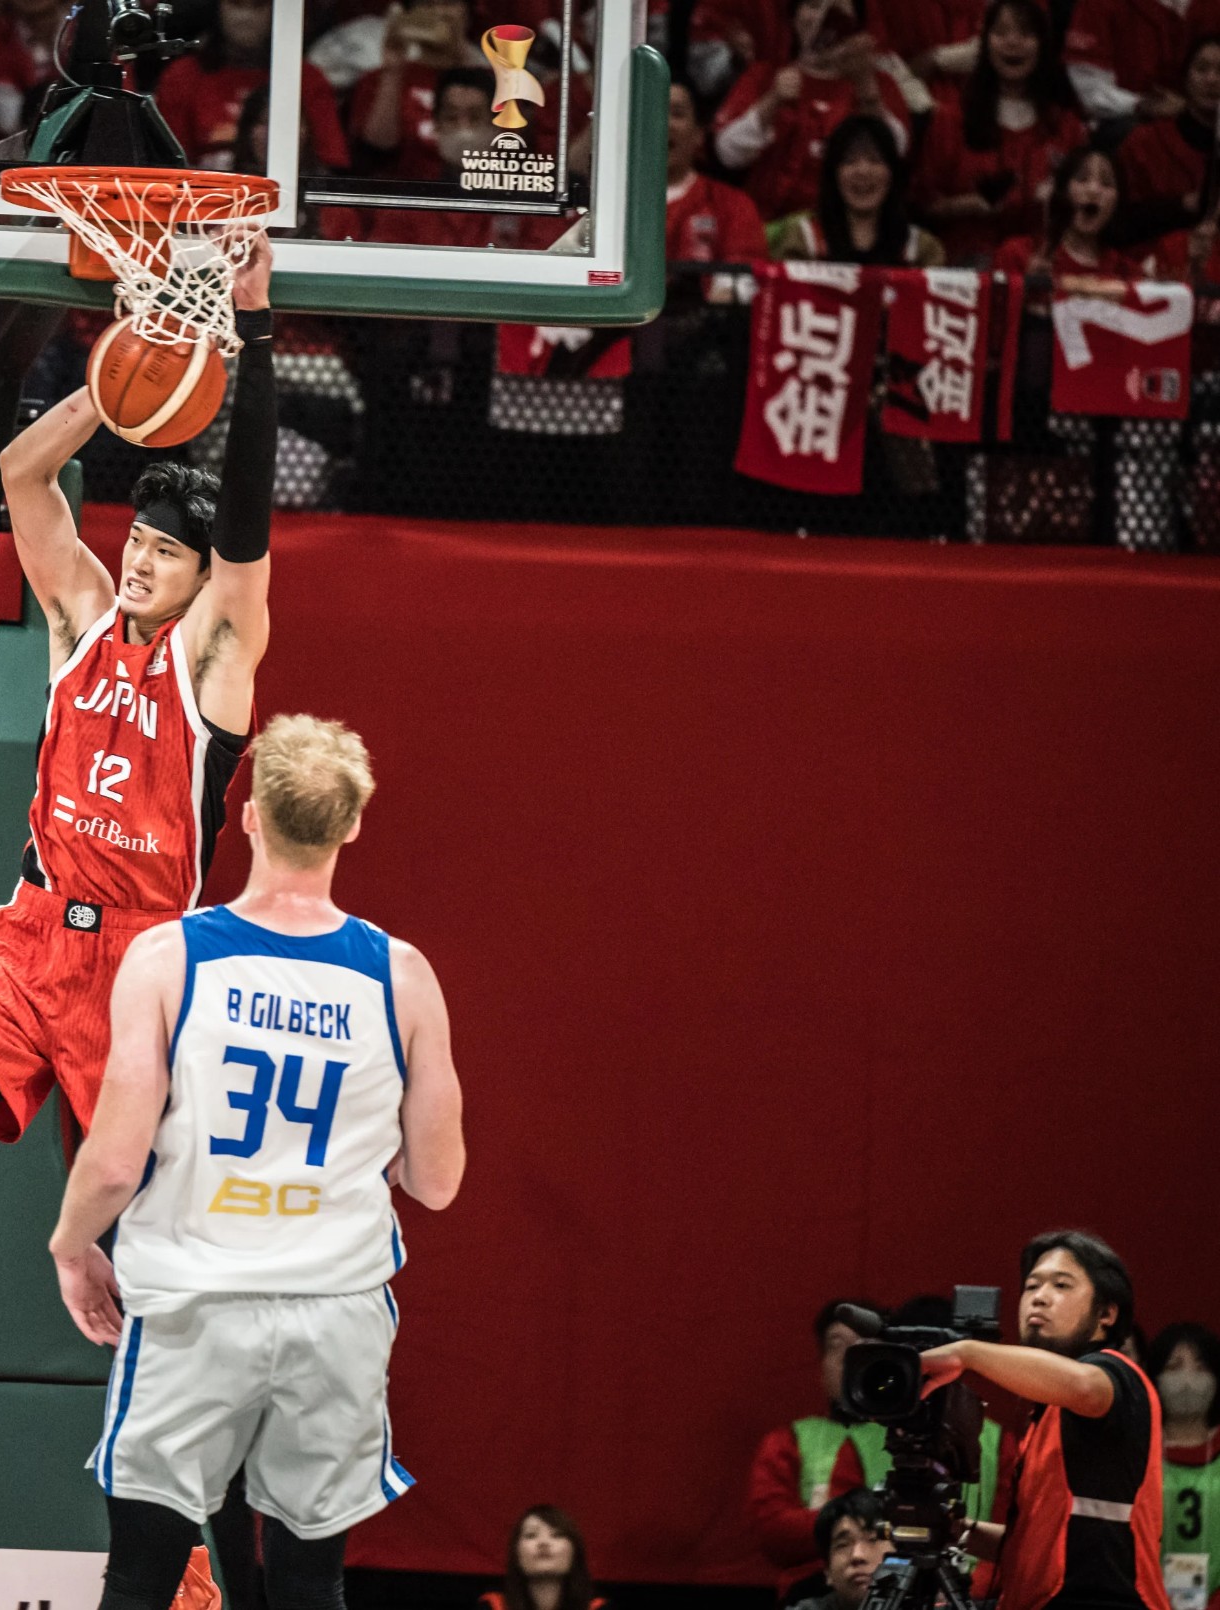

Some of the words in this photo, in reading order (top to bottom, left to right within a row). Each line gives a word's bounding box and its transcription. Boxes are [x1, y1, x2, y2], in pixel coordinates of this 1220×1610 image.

[461, 157, 520, 172] WORLD
[521, 161, 555, 174] CUP
[462, 150, 554, 160] BASKETBALL
[461, 172, 555, 192] QUALIFIERS
[87, 749, 132, 804] 12
[209, 1045, 352, 1168] 34
[207, 1176, 322, 1217] BC
[1176, 1489, 1203, 1540] 3
